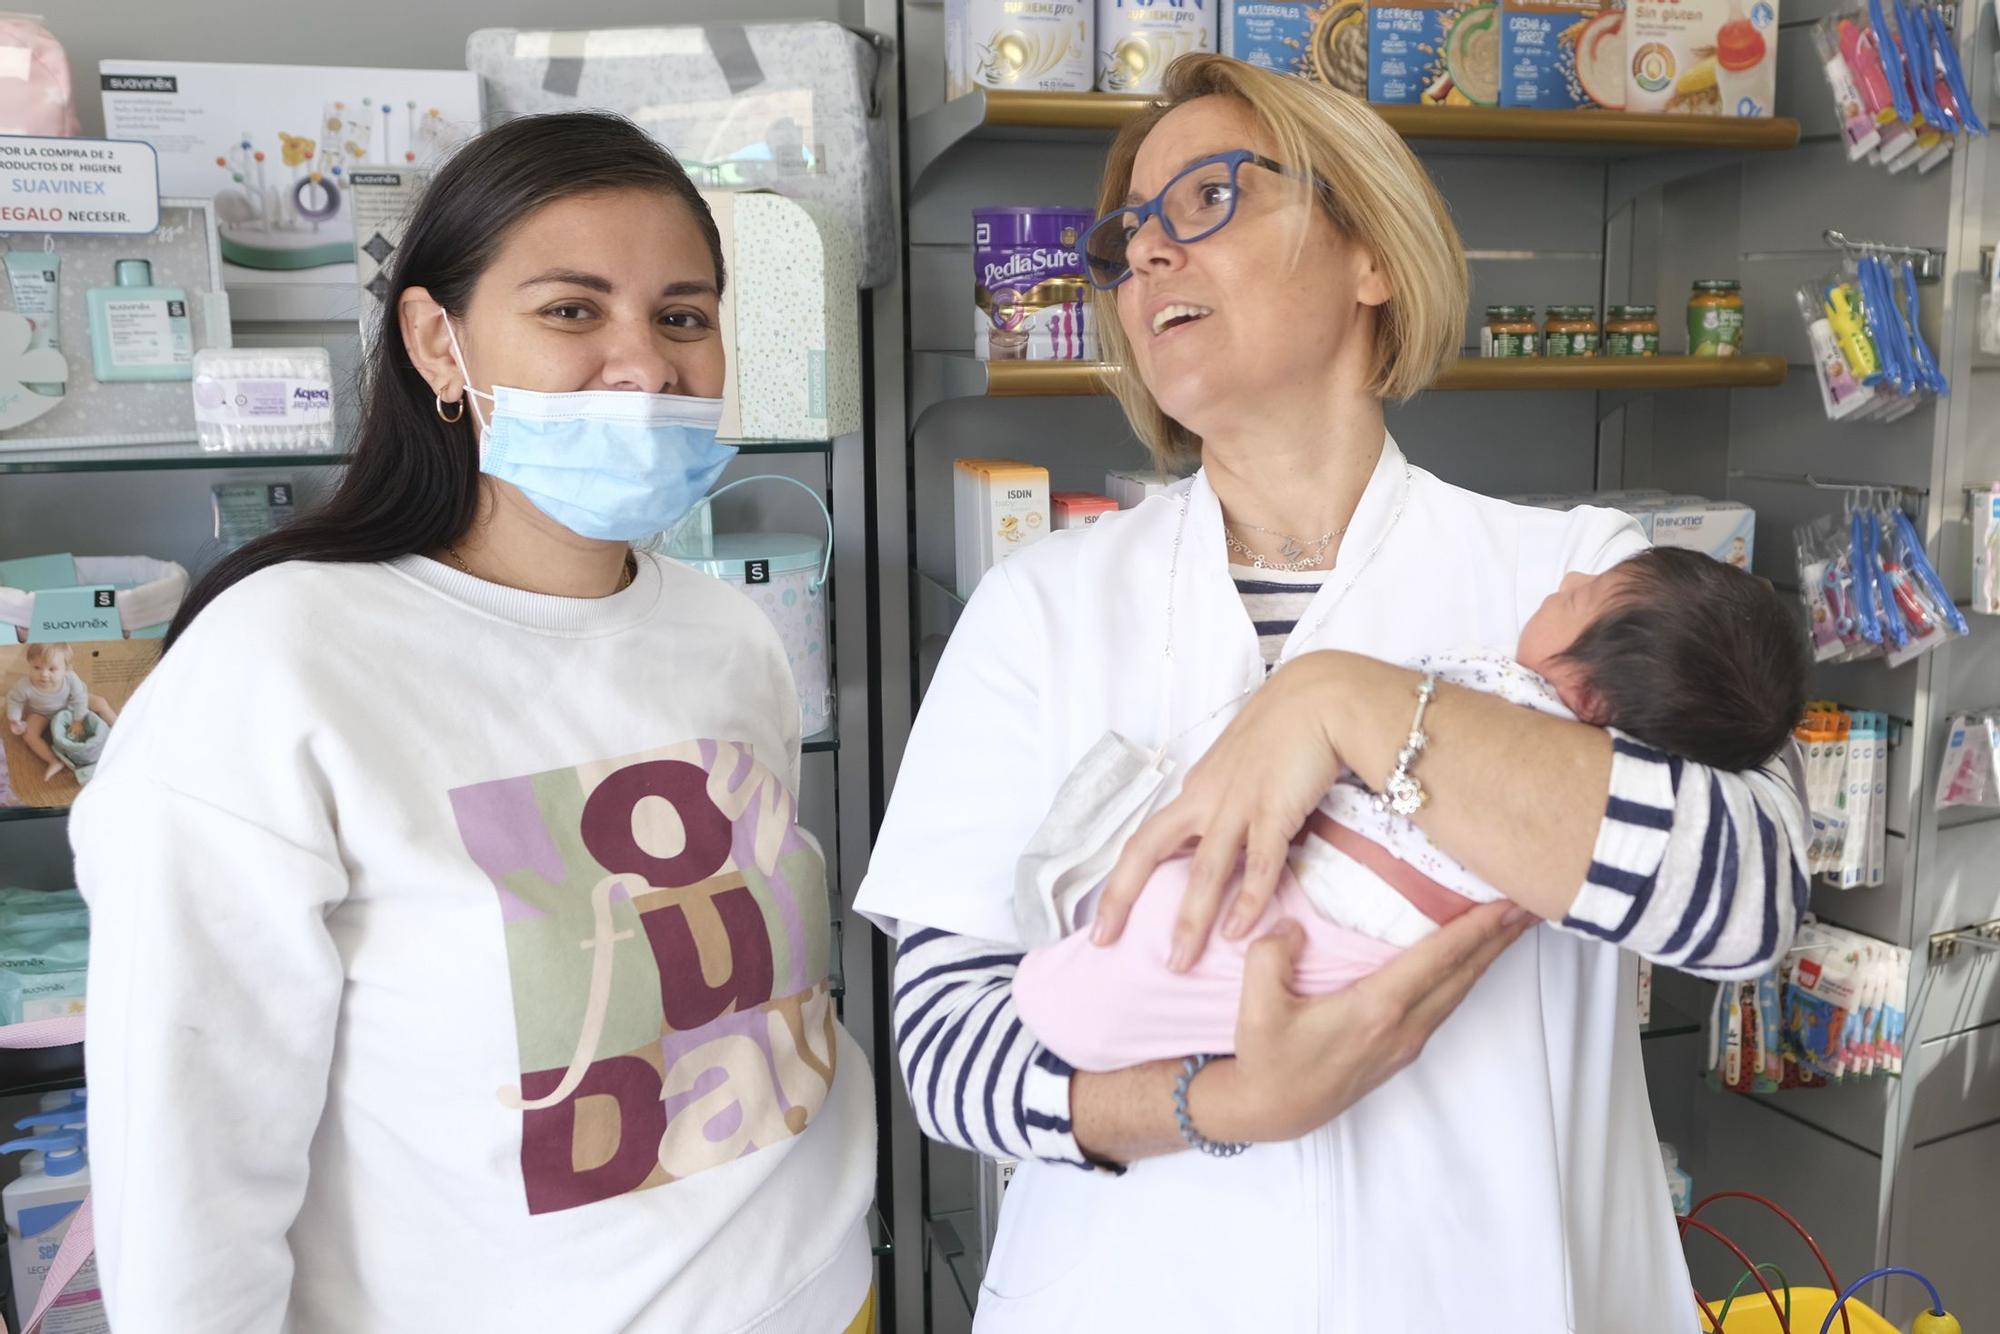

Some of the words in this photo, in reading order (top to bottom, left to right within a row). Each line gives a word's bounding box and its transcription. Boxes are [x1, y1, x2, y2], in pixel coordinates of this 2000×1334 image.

[23, 147, 37, 156] LA
[40, 148, 88, 159] COMPRA
[91, 150, 104, 160] DE
[108, 151, 114, 160] 2
[61, 163, 75, 173] DE
[79, 164, 123, 174] HIGIENE
[12, 178, 105, 195] SUAVINEX
[0, 206, 63, 221] EGALO
[68, 210, 131, 224] NECESER.
[985, 247, 1081, 287] PediaSure
[1007, 489, 1032, 499] ISDIN
